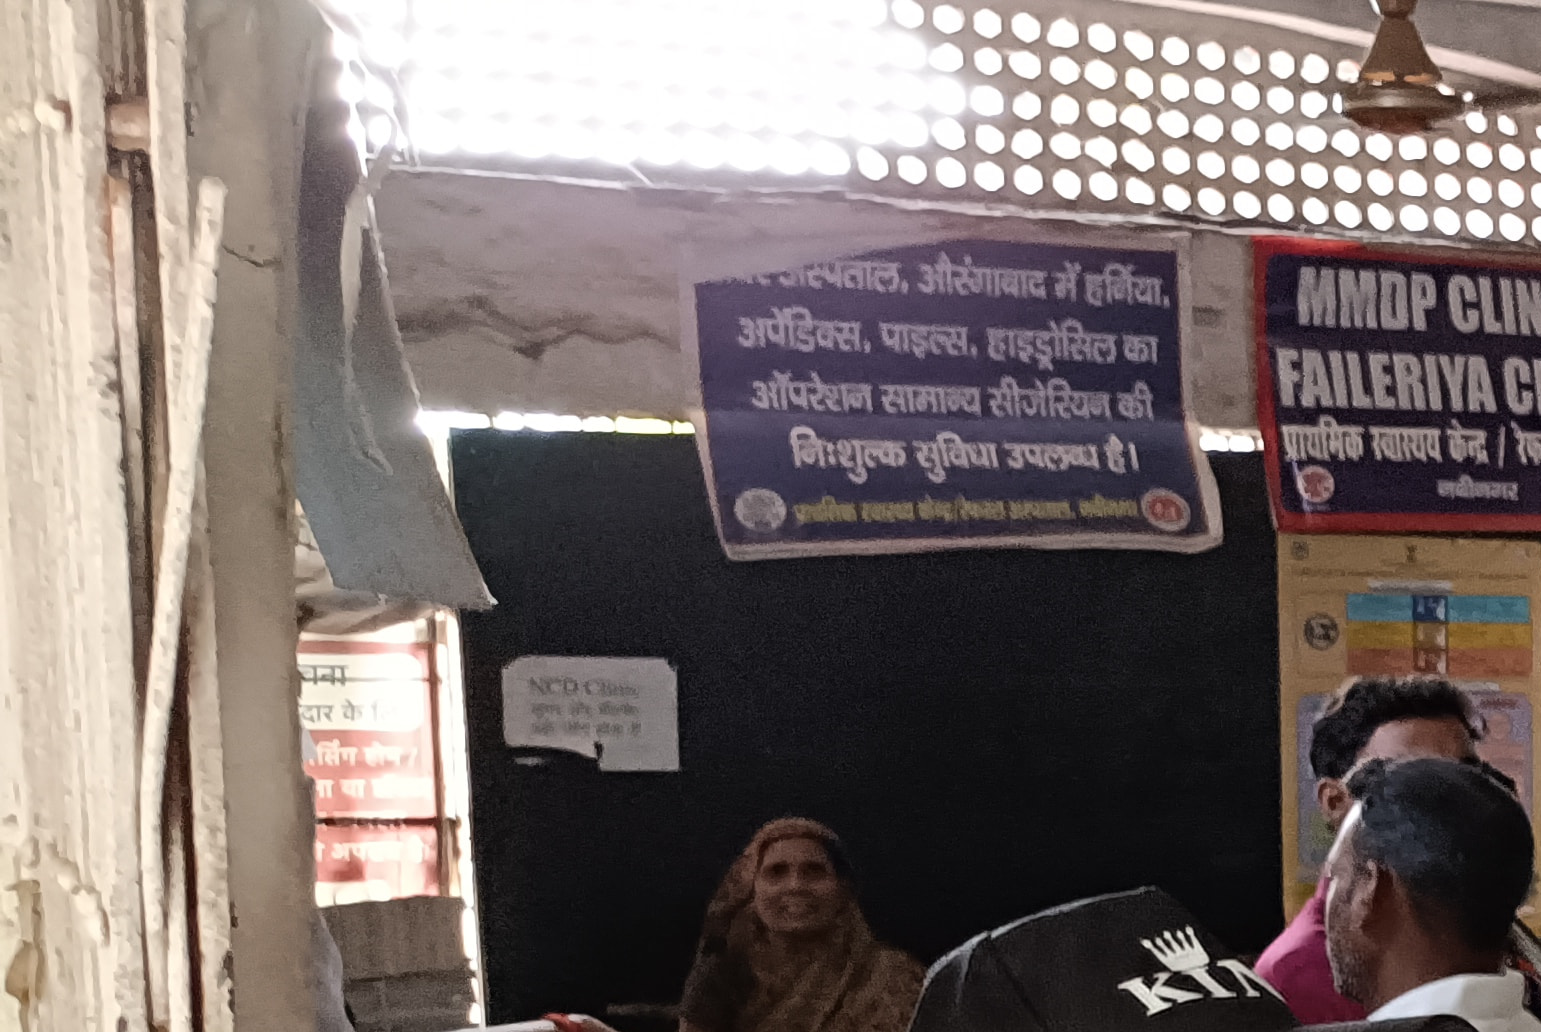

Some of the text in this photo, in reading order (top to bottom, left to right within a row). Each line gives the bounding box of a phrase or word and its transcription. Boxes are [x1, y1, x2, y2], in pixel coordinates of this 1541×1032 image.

[1053, 262, 1082, 303] में
[1085, 263, 1171, 308] हर्निया,
[1297, 265, 1437, 333] MMDP
[737, 304, 1159, 370] अपेंडिक्स, पाइल्स, हाइड्रोसिल का
[752, 370, 1155, 422] ऑपरेशन सामान्य सीजेरियन की
[1276, 346, 1498, 414] FAILERIYA
[789, 425, 1141, 485] निःशुल्क सुविधा उपलब्ध है।
[1281, 414, 1365, 462] प्राथमिक
[298, 663, 348, 686] चना
[298, 702, 335, 723] दार
[1117, 957, 1288, 1017] KIN
